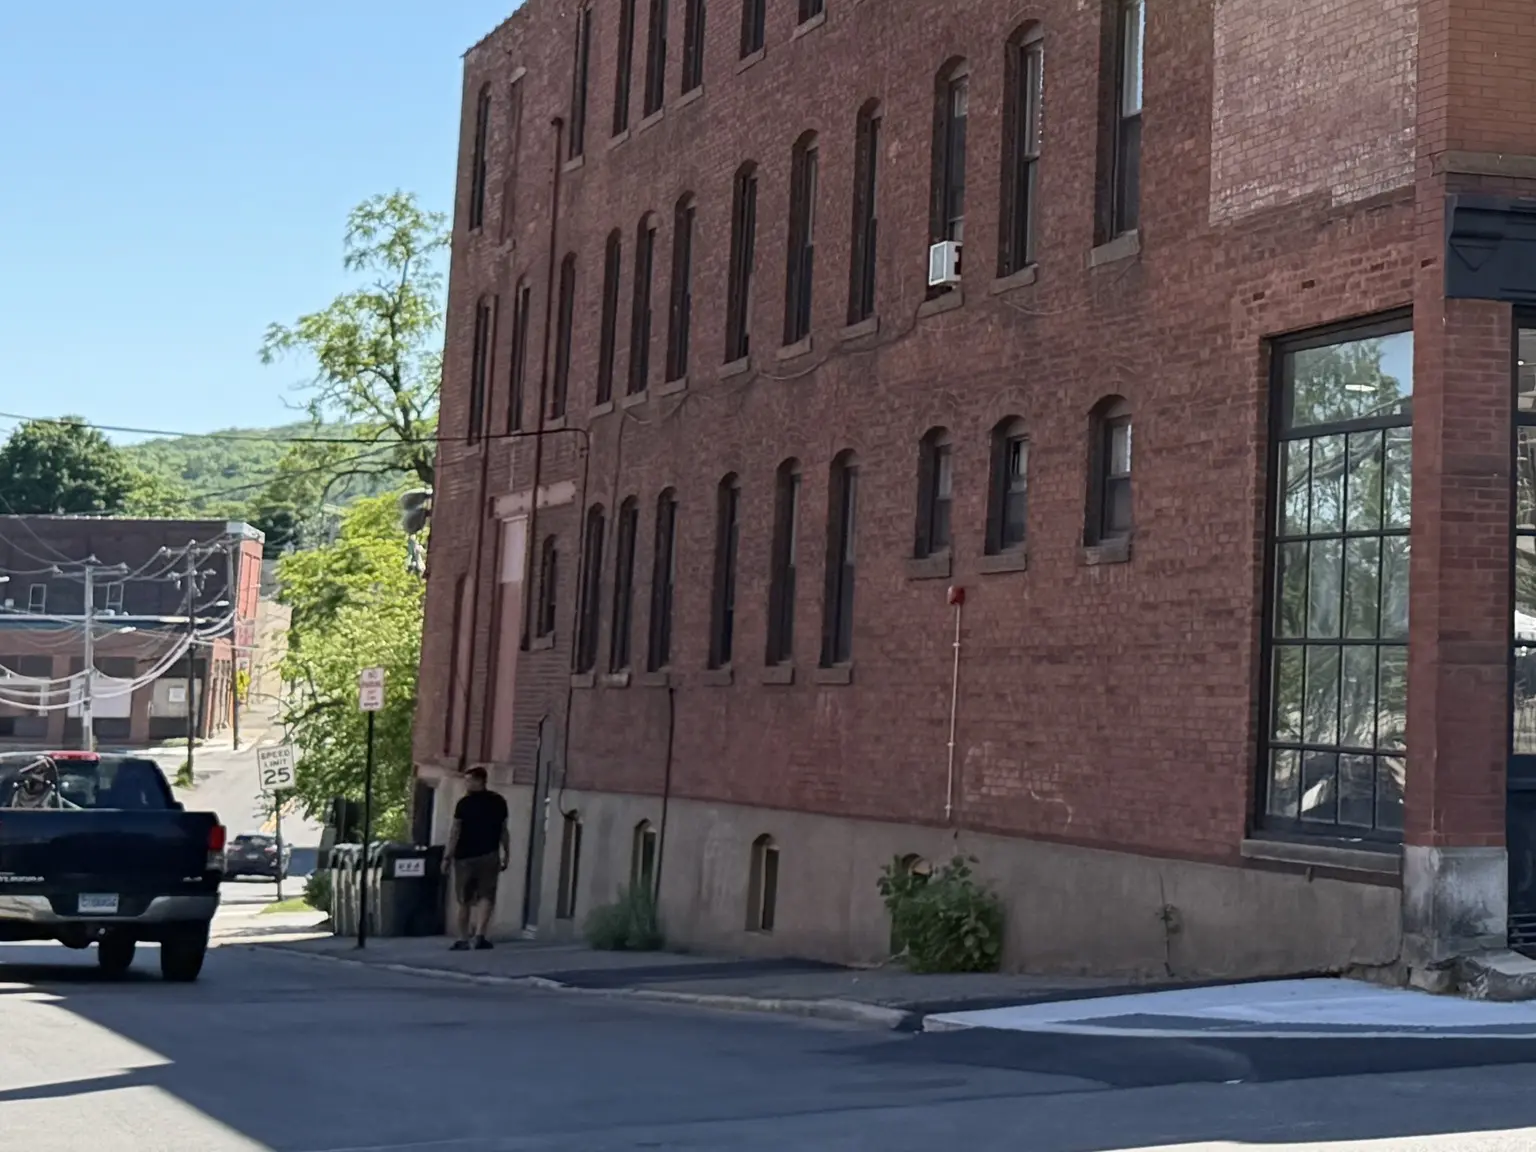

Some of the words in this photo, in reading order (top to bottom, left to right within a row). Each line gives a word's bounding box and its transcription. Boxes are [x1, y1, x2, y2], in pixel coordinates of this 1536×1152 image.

[261, 749, 289, 760] SPEED
[264, 758, 286, 767] LIMIT
[263, 767, 290, 785] 25
